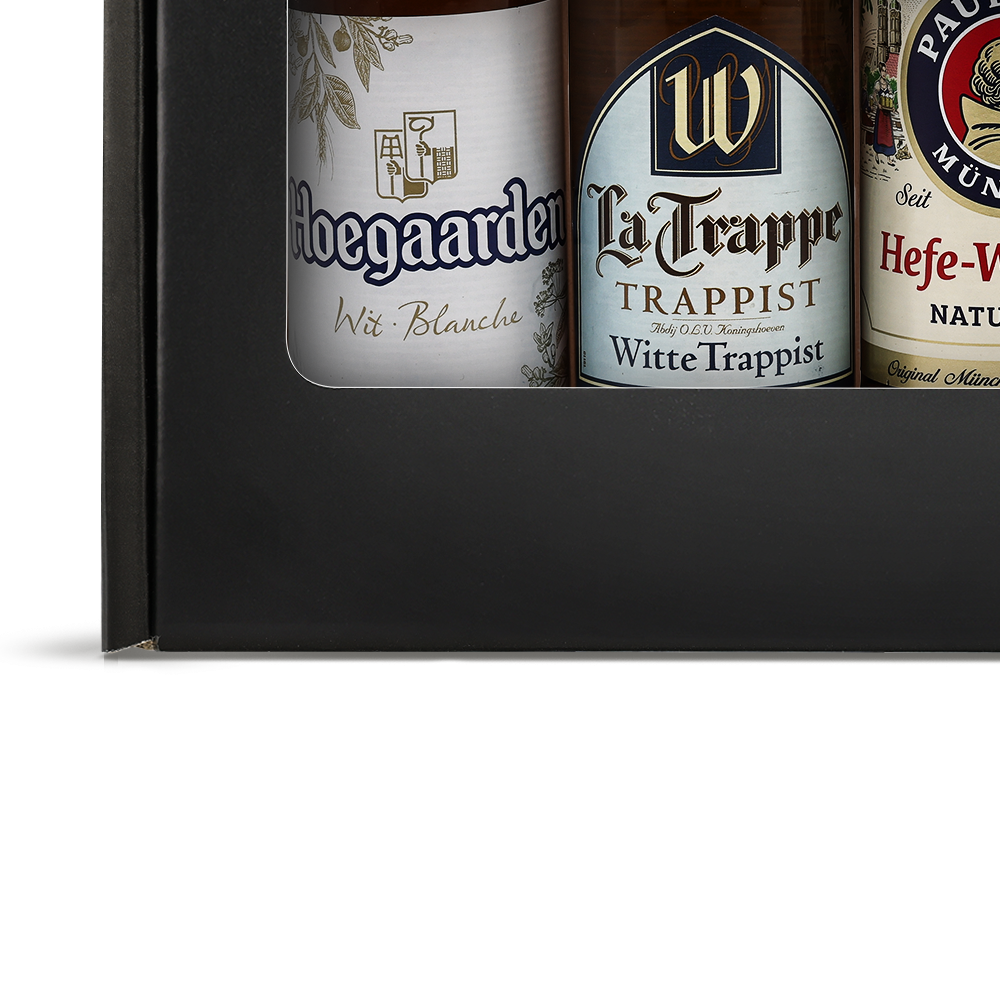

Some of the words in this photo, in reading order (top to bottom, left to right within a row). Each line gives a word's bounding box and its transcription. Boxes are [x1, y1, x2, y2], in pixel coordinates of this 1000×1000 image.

[665, 64, 761, 155] W
[895, 182, 933, 209] Seit
[288, 176, 565, 287] Hoegaarden
[587, 183, 652, 277] La
[647, 186, 844, 278] Trappe
[334, 296, 384, 338] Wit
[398, 297, 524, 341] Blanche
[615, 278, 821, 316] TRAPPIST
[650, 322, 678, 337] Abdij
[609, 335, 697, 372] Witte
[697, 336, 824, 379] Trappist
[887, 359, 941, 384] Original
